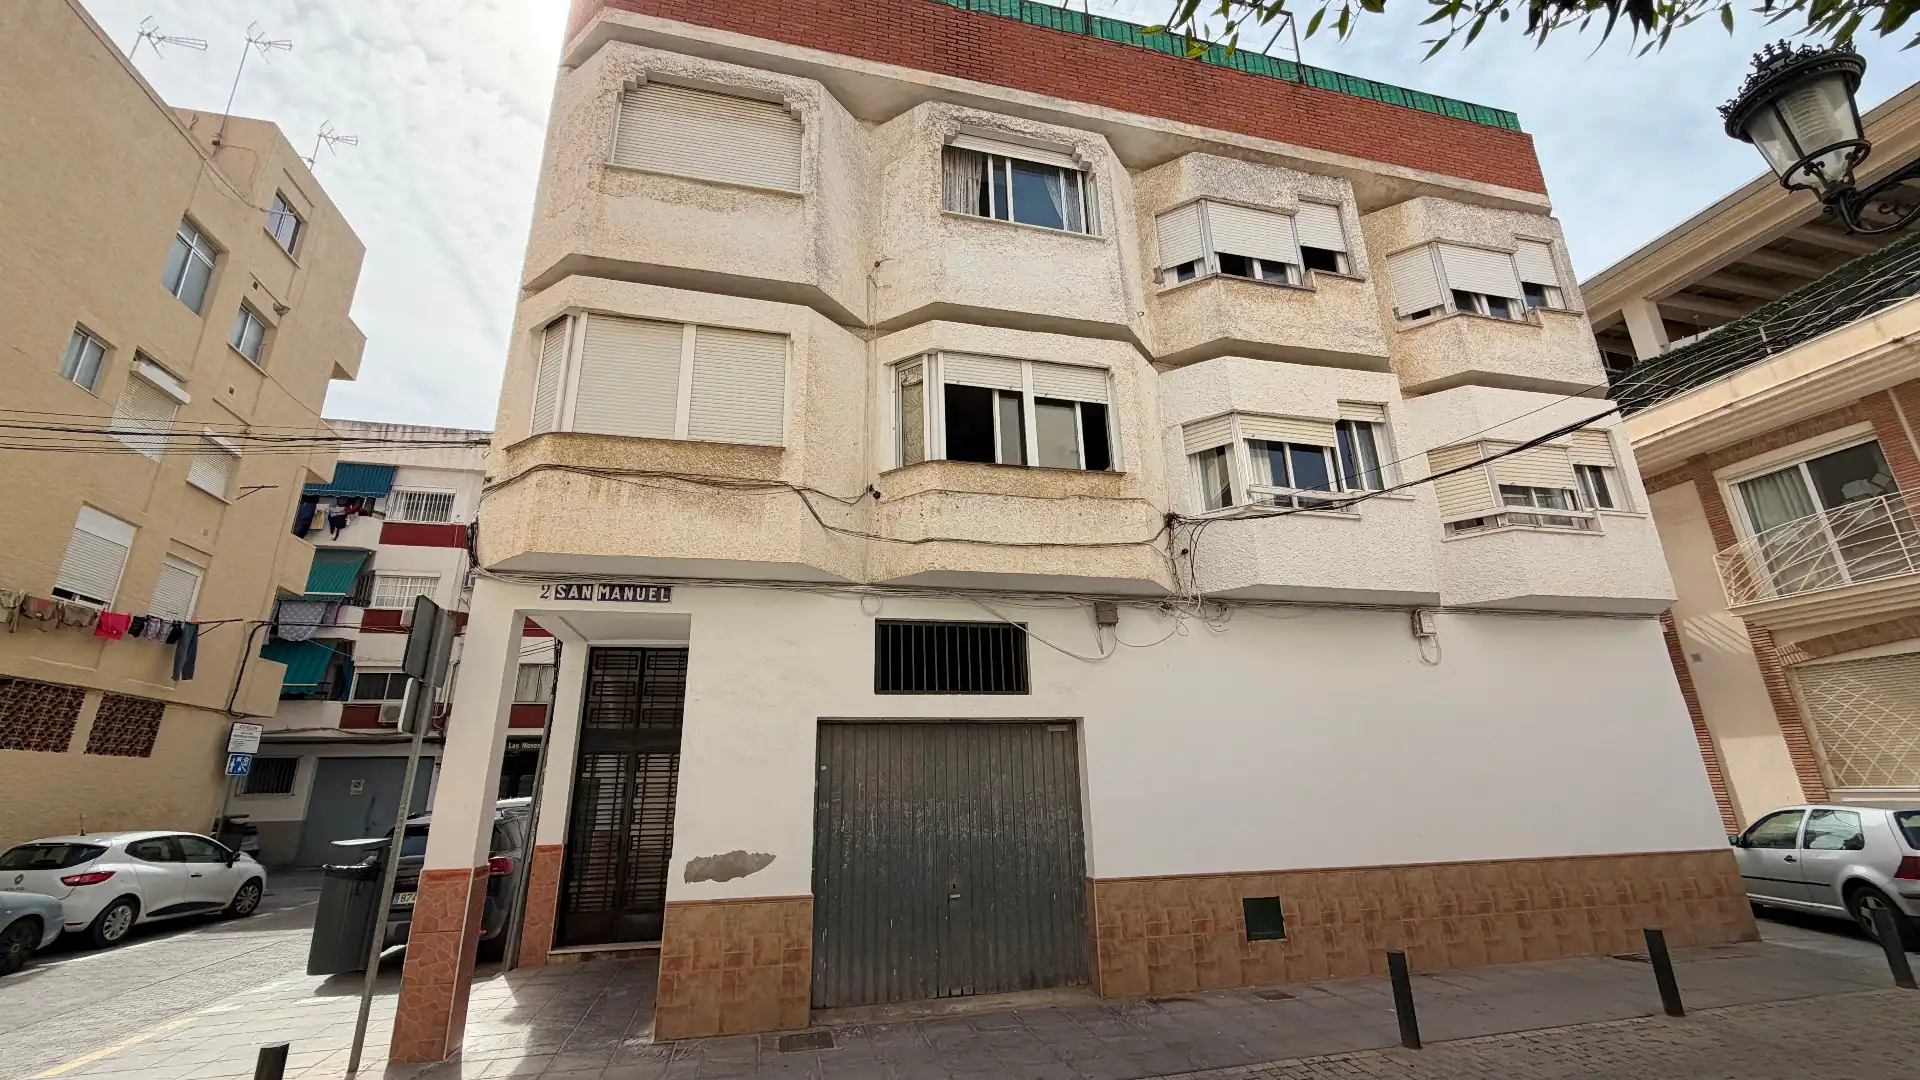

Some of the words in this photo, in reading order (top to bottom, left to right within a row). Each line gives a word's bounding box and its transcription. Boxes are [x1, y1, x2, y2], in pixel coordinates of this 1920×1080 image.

[540, 585, 550, 599] 2
[556, 585, 592, 599] SAN
[598, 586, 669, 601] MANUEL
